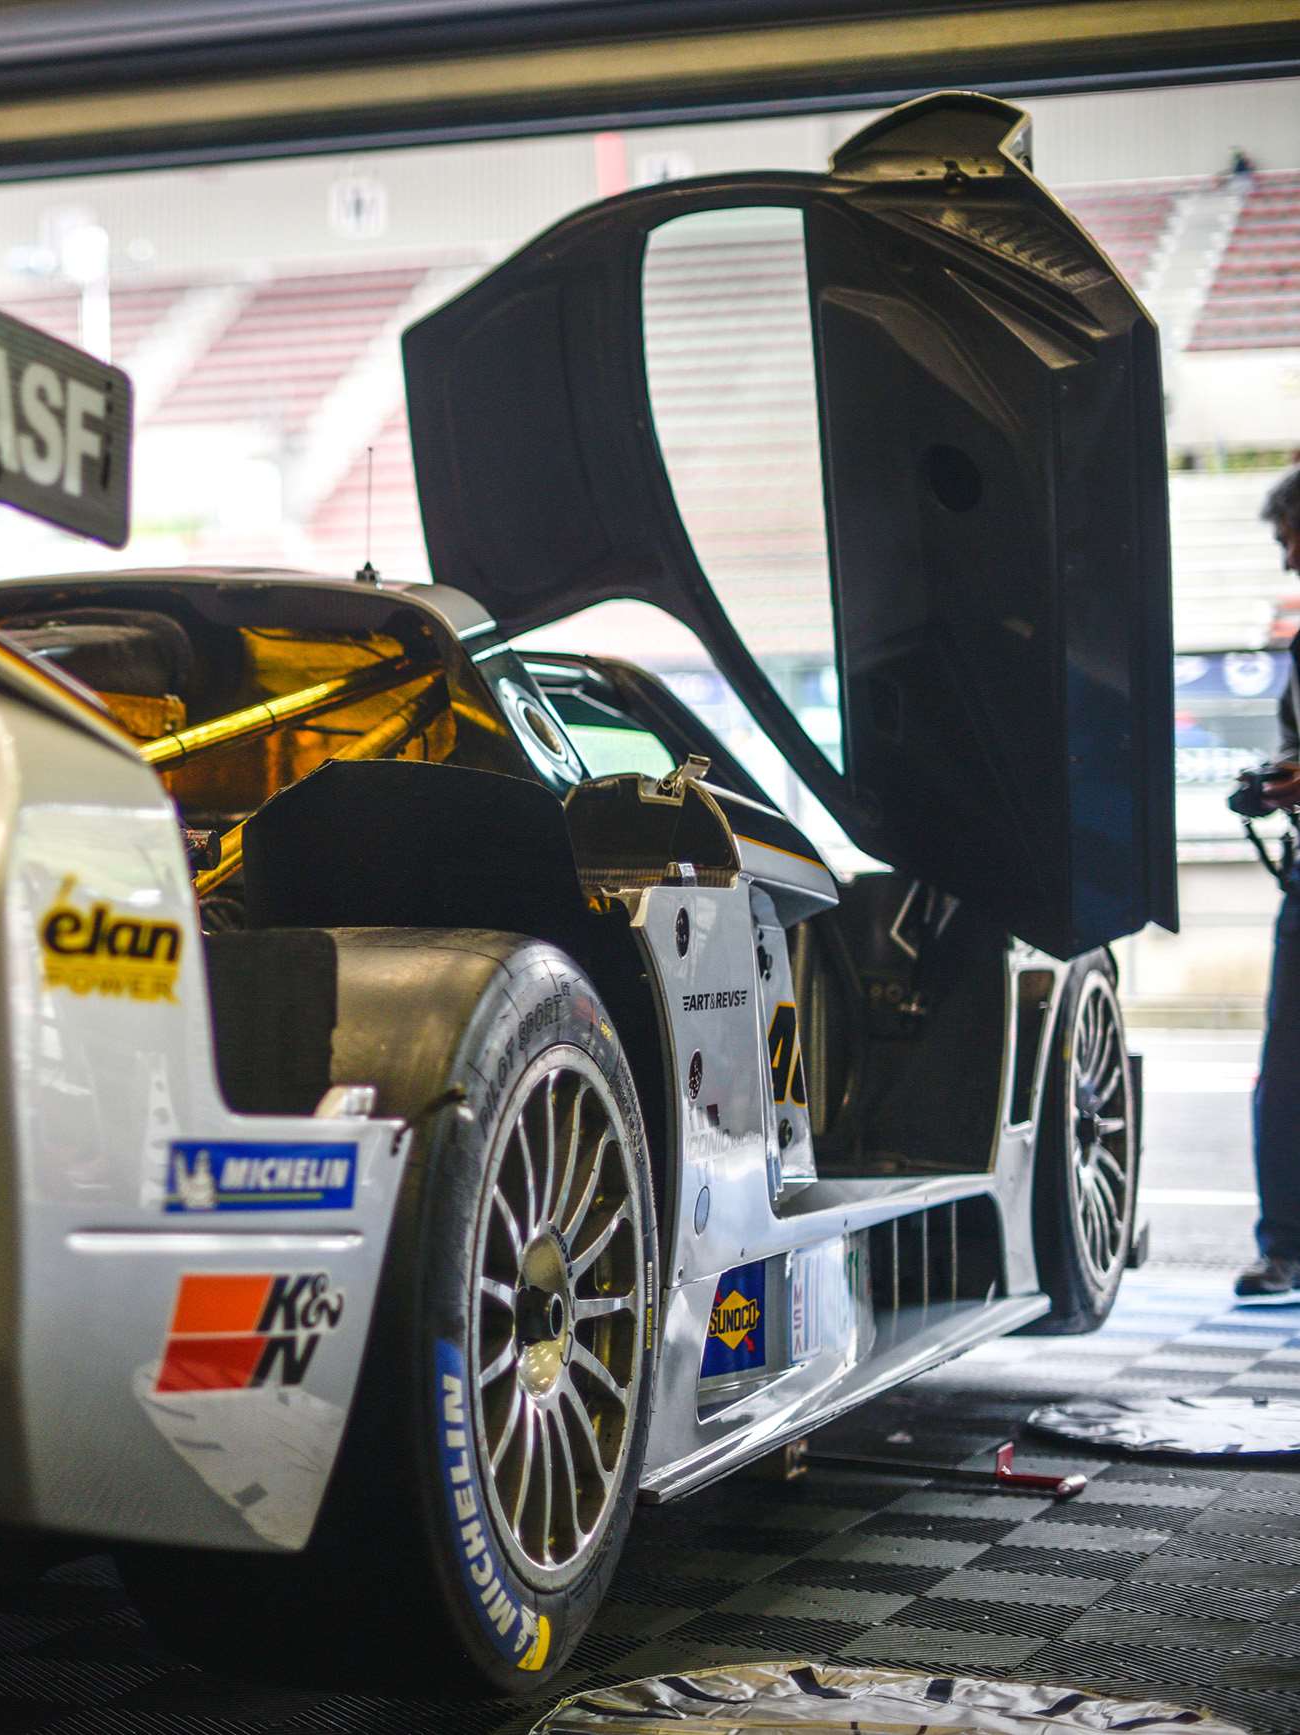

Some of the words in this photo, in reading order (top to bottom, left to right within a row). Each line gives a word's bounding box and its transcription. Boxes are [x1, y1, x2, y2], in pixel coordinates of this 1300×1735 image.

[44, 965, 182, 1004] POWER
[687, 990, 742, 1012] ART&REVS
[768, 1001, 808, 1107] 4
[218, 1157, 350, 1191] MICHELIN
[708, 1301, 757, 1336] SUNOCO
[442, 1373, 518, 1638] MICHELIN
